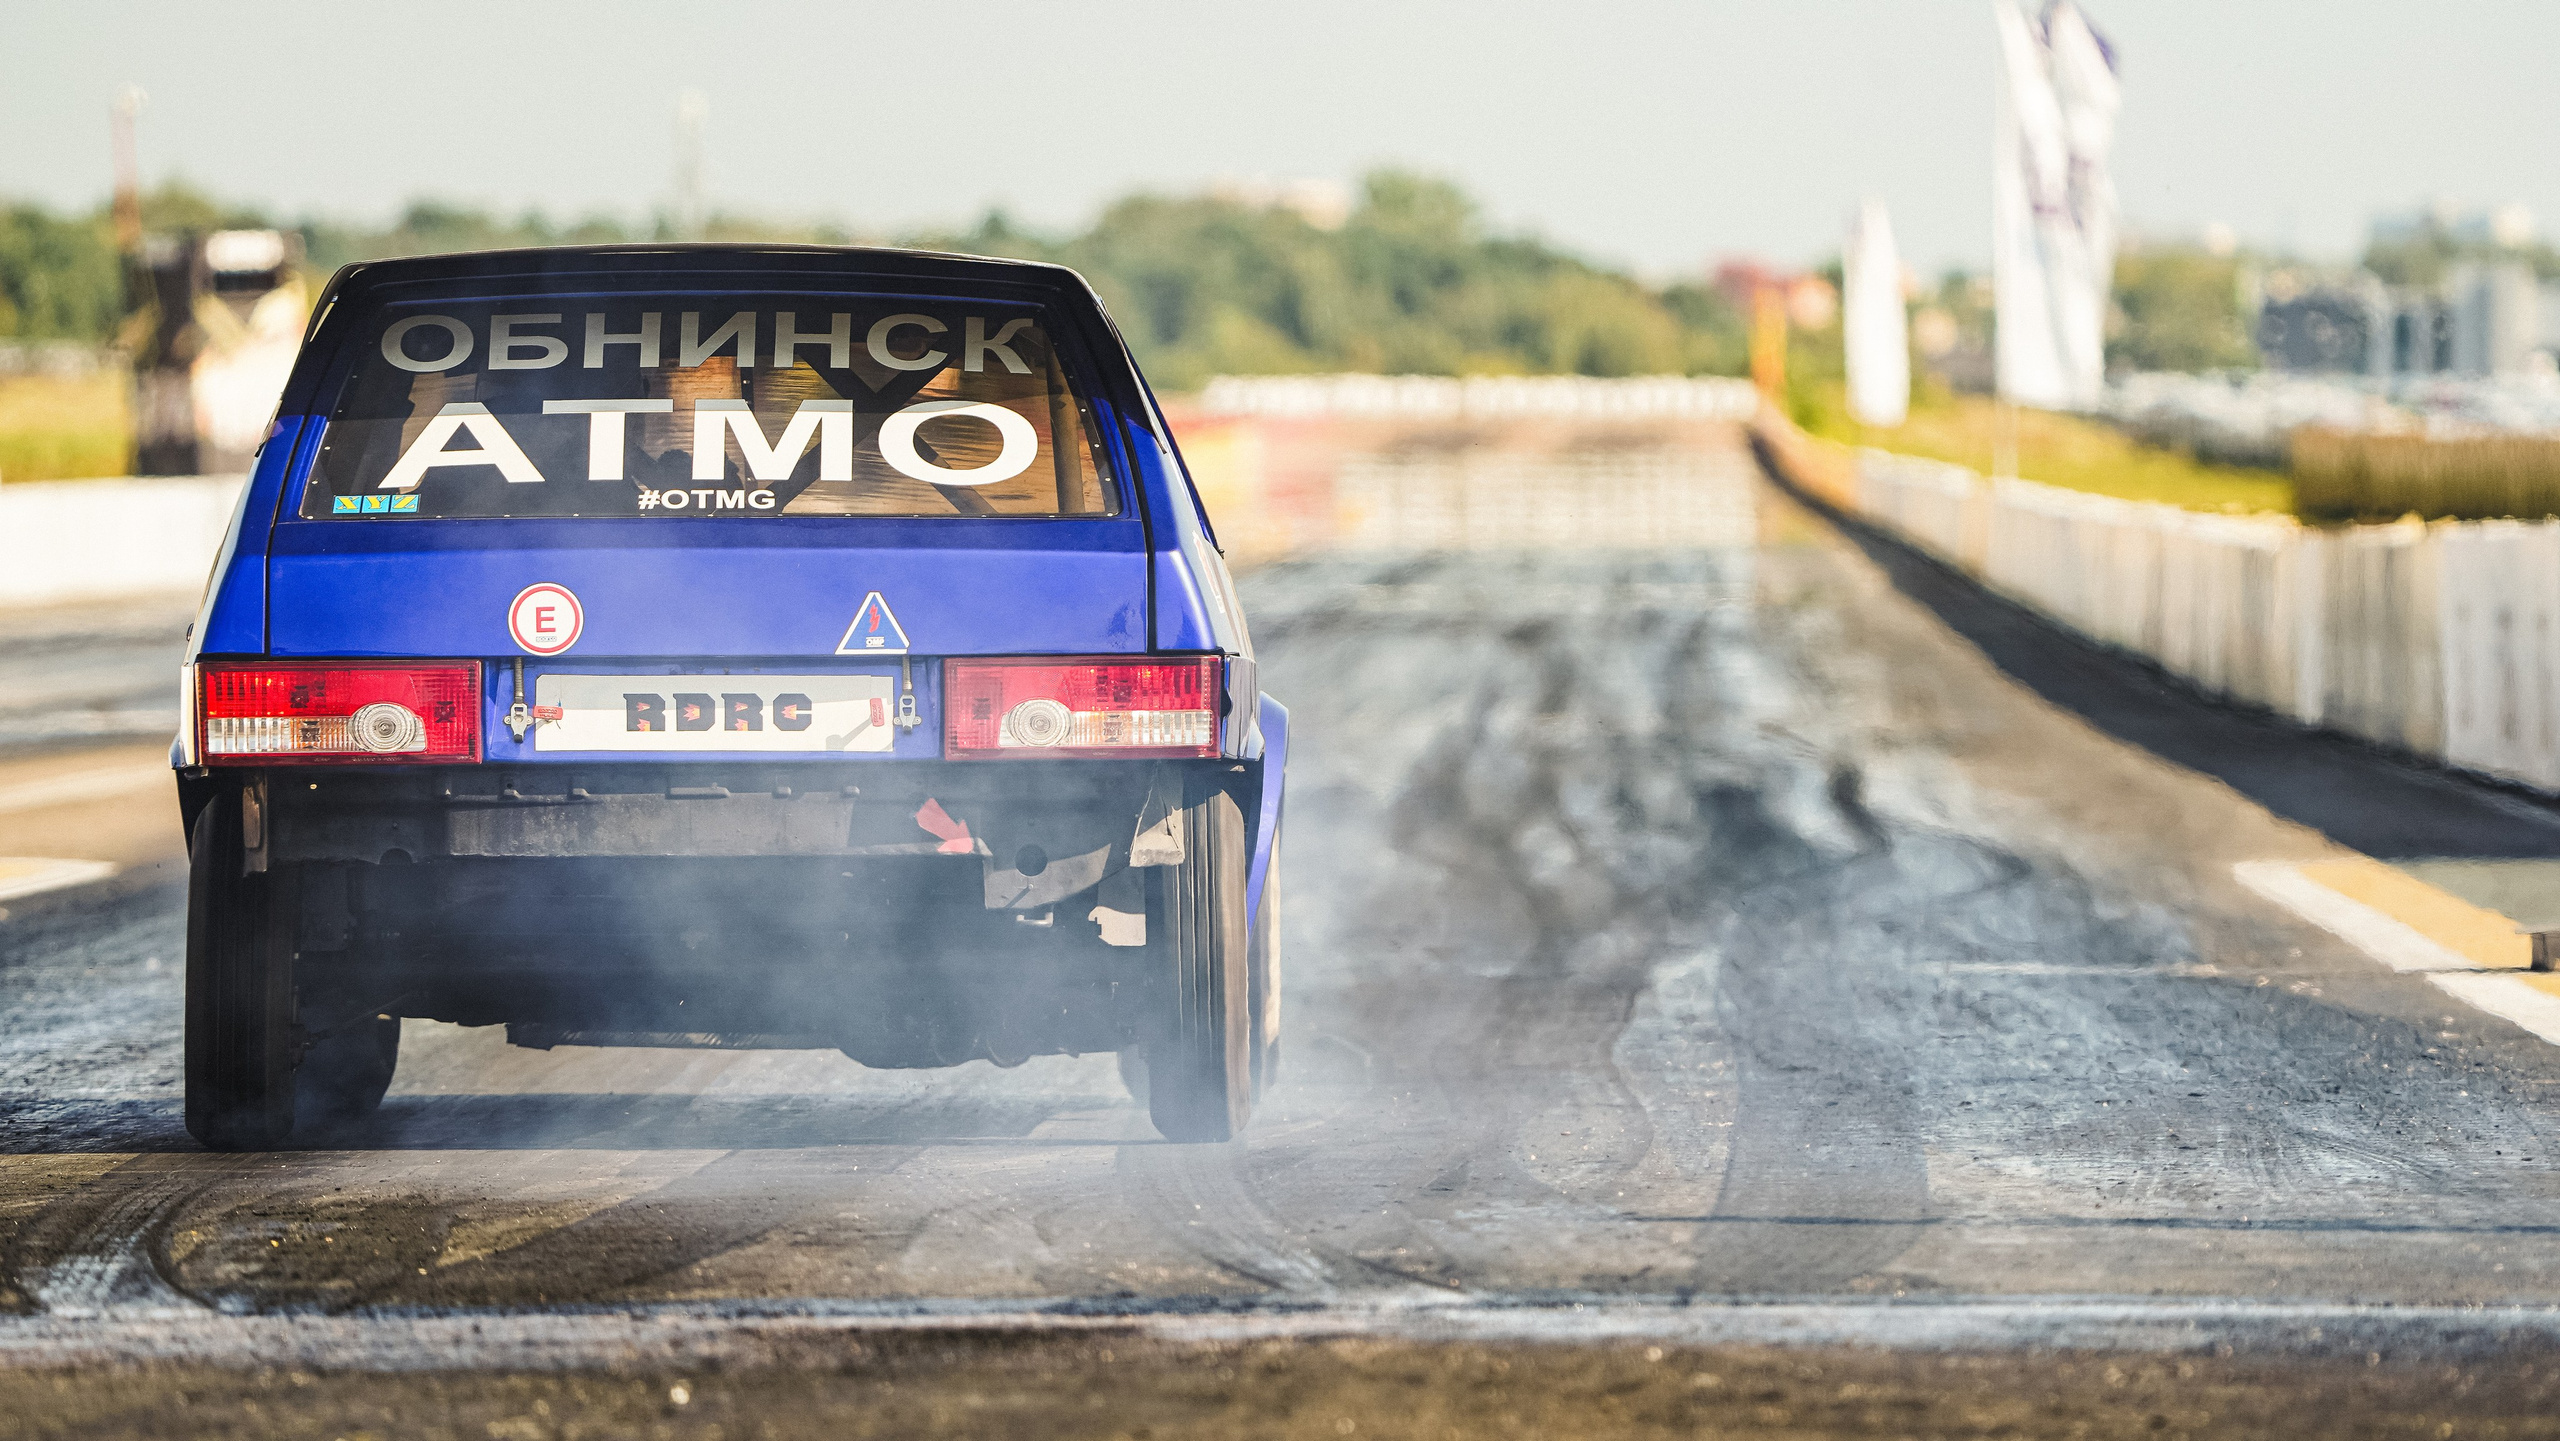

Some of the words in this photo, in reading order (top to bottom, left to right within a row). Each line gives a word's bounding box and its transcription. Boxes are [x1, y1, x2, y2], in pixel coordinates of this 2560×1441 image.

[381, 311, 1034, 375] ОБНИНСК
[378, 399, 1039, 488] АТМО
[335, 495, 418, 510] XYZ
[638, 489, 776, 509] #OTMG
[535, 606, 557, 633] E
[623, 693, 813, 731] RDRC
